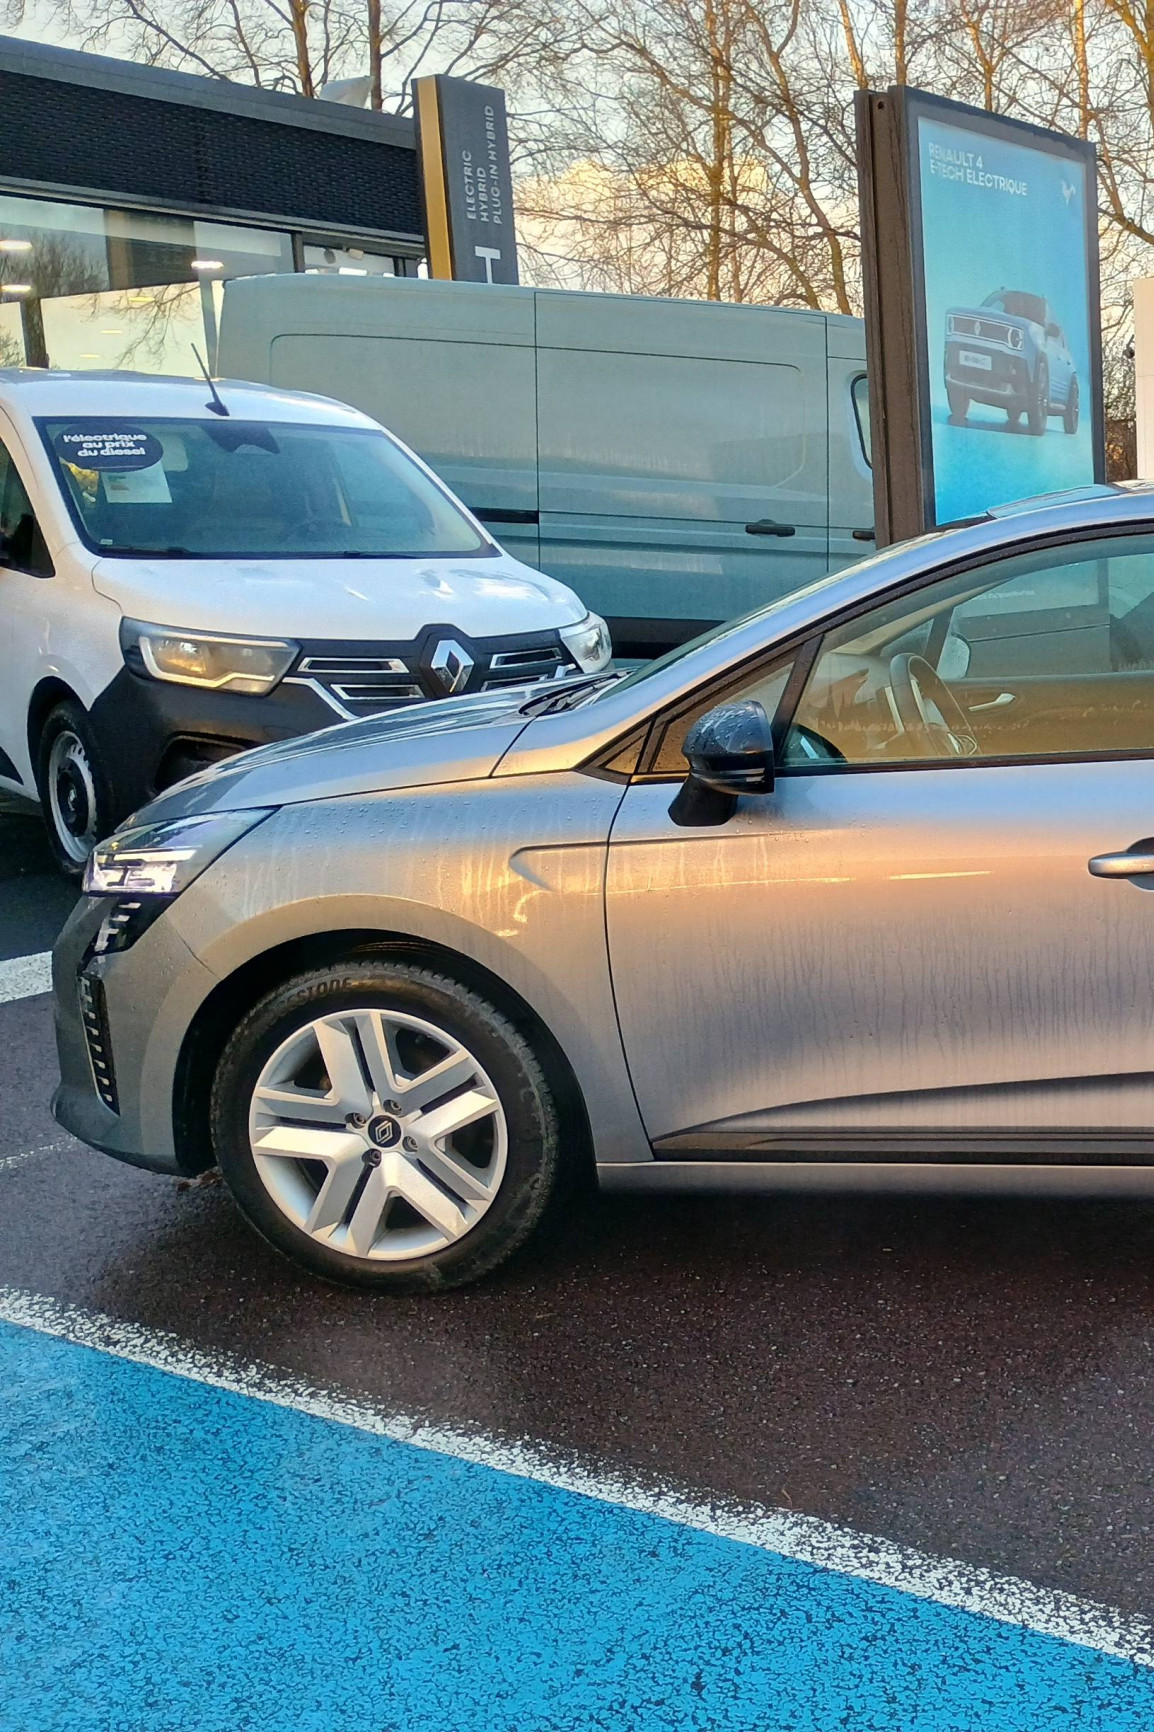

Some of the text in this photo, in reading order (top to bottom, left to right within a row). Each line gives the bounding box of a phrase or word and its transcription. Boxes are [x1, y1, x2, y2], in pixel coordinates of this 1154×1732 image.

[484, 105, 503, 225] PLUG-IN HYBRID
[928, 142, 983, 170] RENAULT 4
[462, 150, 477, 220] ELECTRIC
[476, 166, 490, 222] HYBRID
[77, 447, 146, 457] du diesel
[82, 440, 136, 450] au prix
